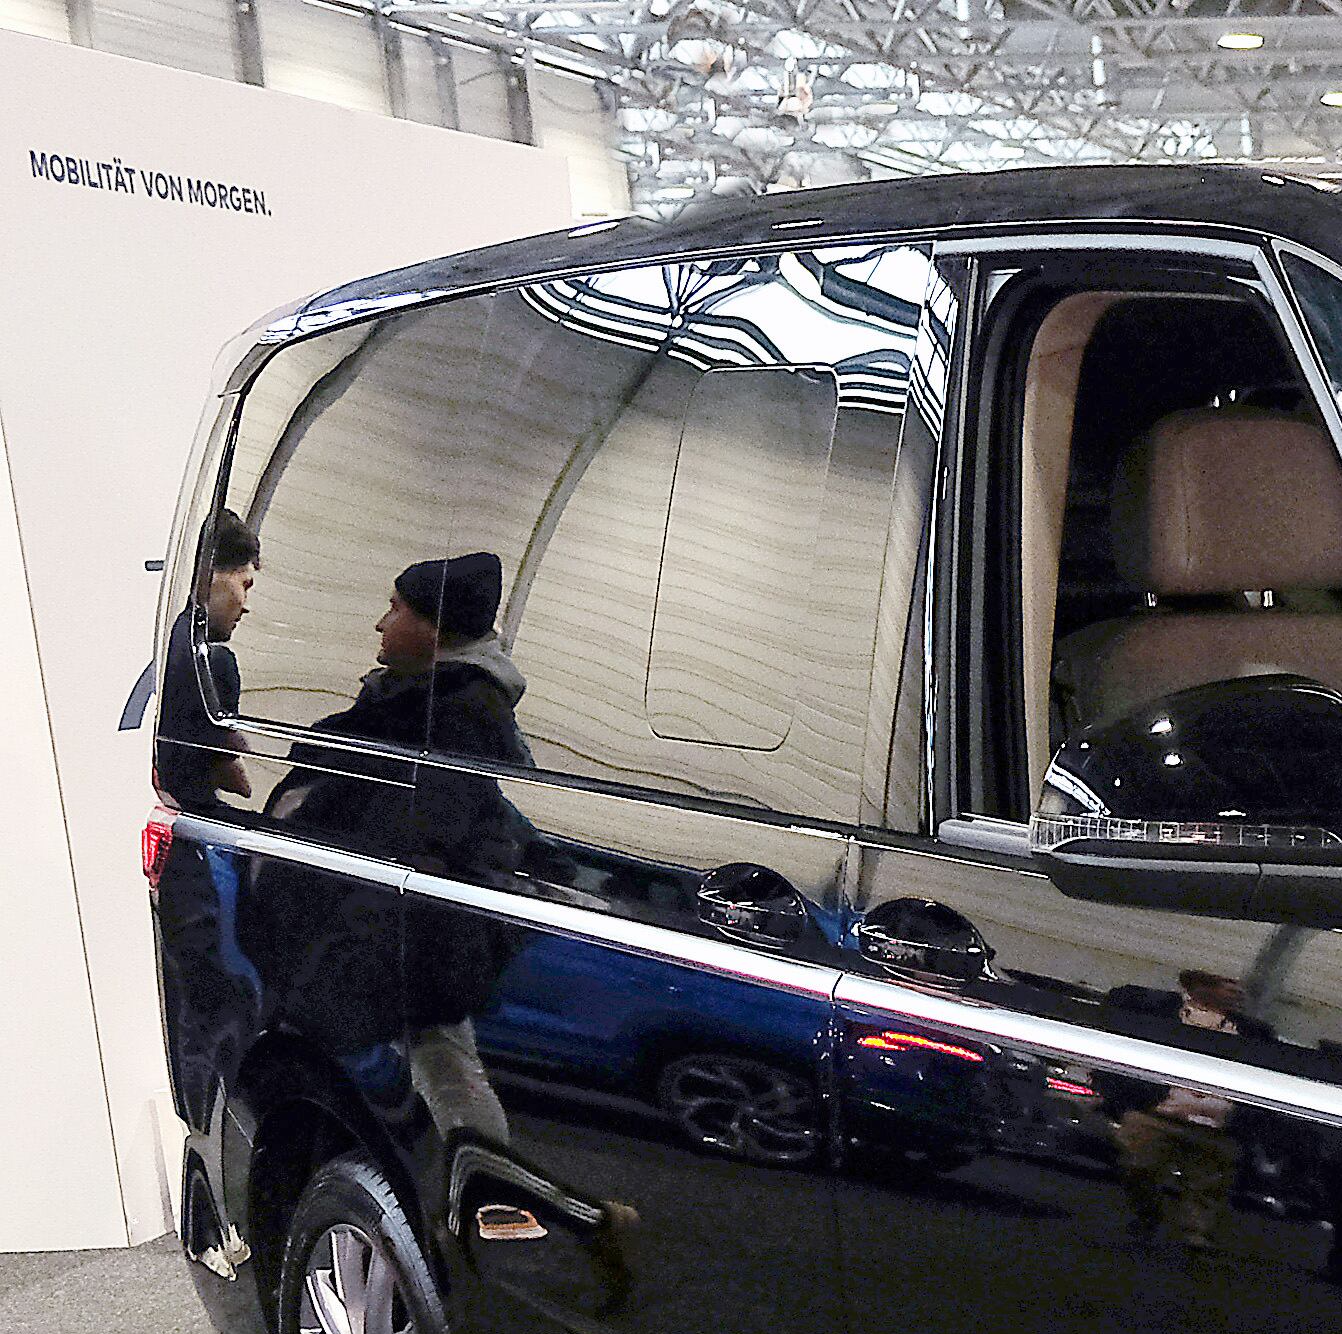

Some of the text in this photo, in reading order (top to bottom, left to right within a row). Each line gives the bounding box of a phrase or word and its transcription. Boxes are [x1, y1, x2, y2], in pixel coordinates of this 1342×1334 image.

[29, 149, 273, 217] MOBILITÄT VON MORGEN.
